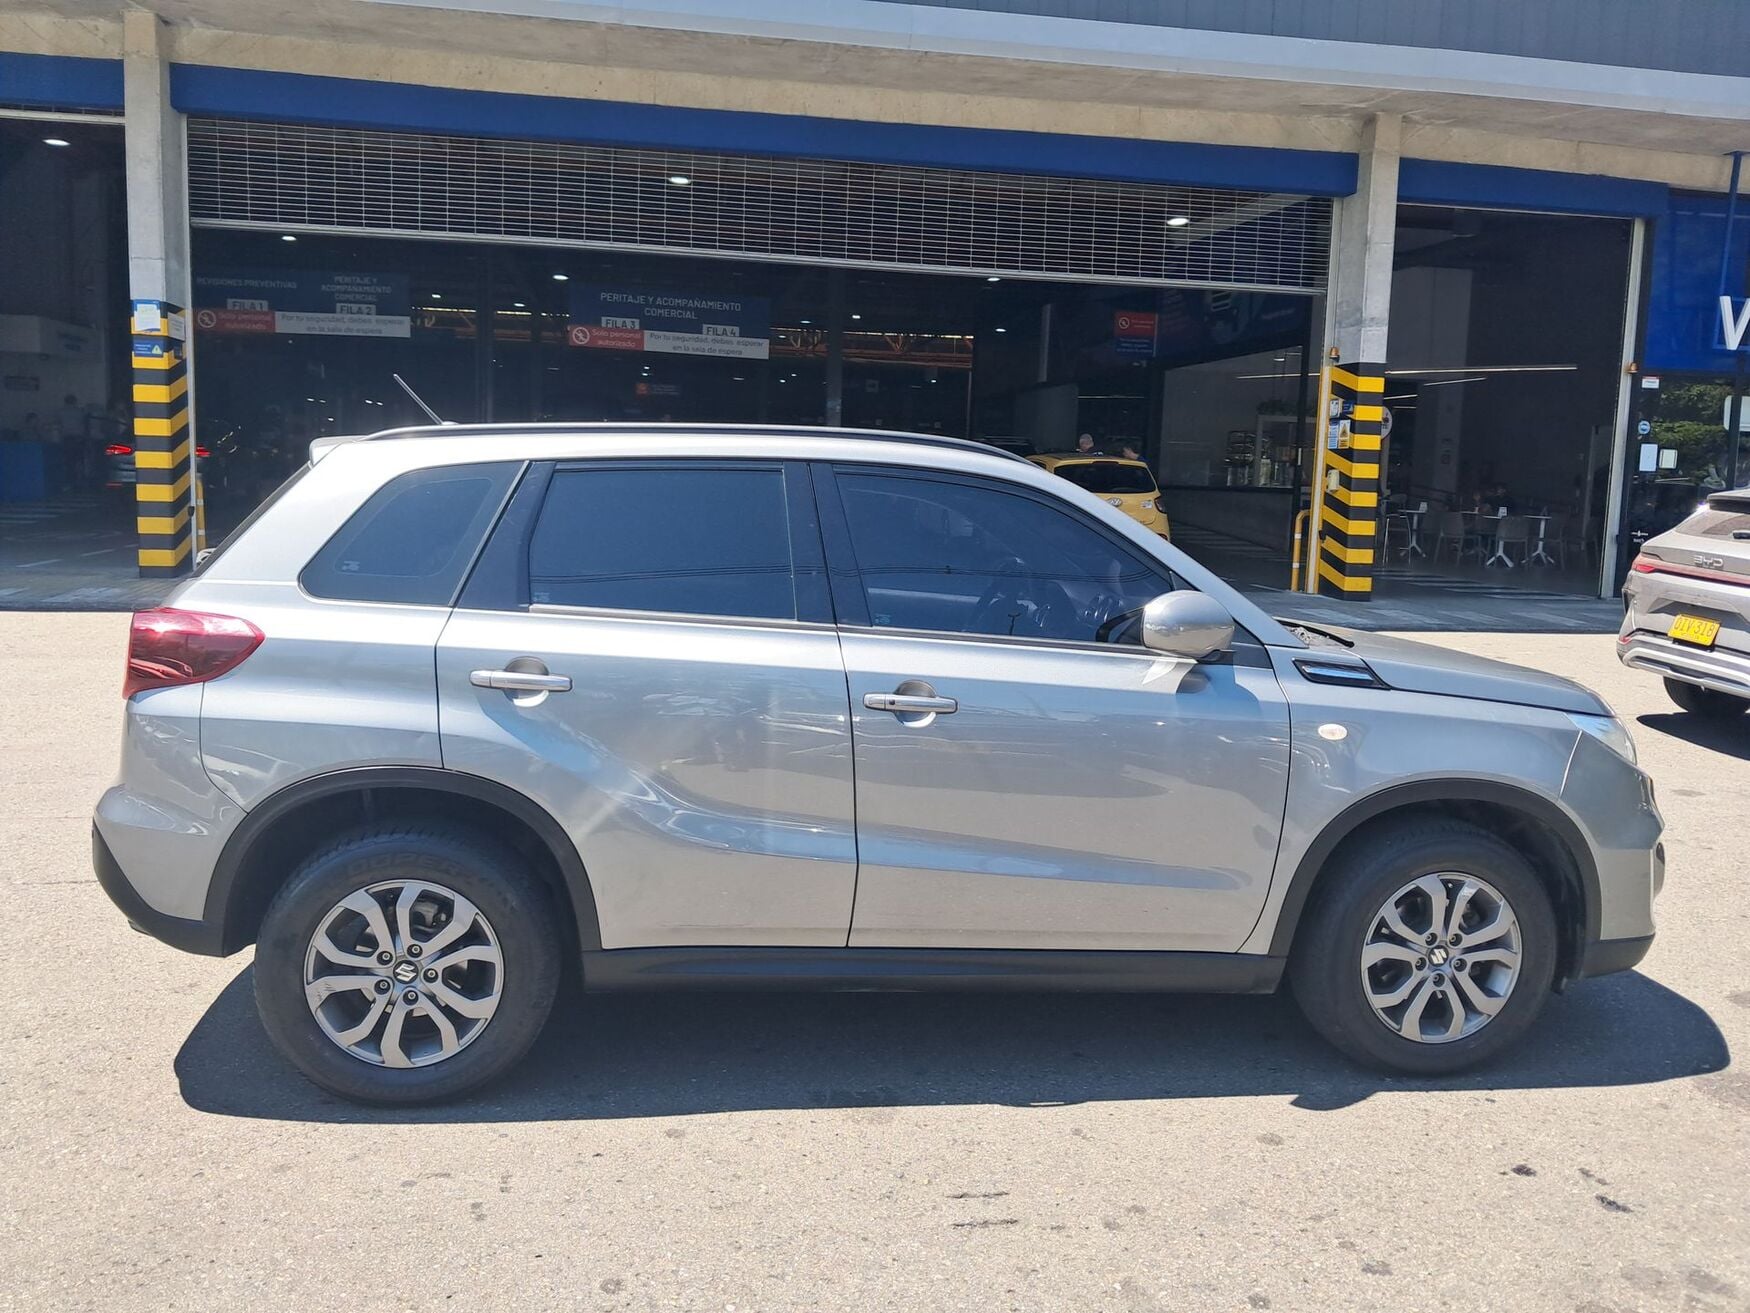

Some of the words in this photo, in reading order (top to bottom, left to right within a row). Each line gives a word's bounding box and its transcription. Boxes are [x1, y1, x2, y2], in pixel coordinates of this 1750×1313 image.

[600, 292, 646, 304] PERITAJE
[648, 296, 655, 304] Y
[655, 297, 741, 311] ACOMPAÑAMIENTO
[340, 305, 364, 315] FILA
[366, 306, 372, 315] 2
[644, 308, 698, 319] COMERCIAL
[606, 319, 628, 328] FILA
[706, 326, 729, 336] FILA
[1694, 555, 1724, 568] BYD
